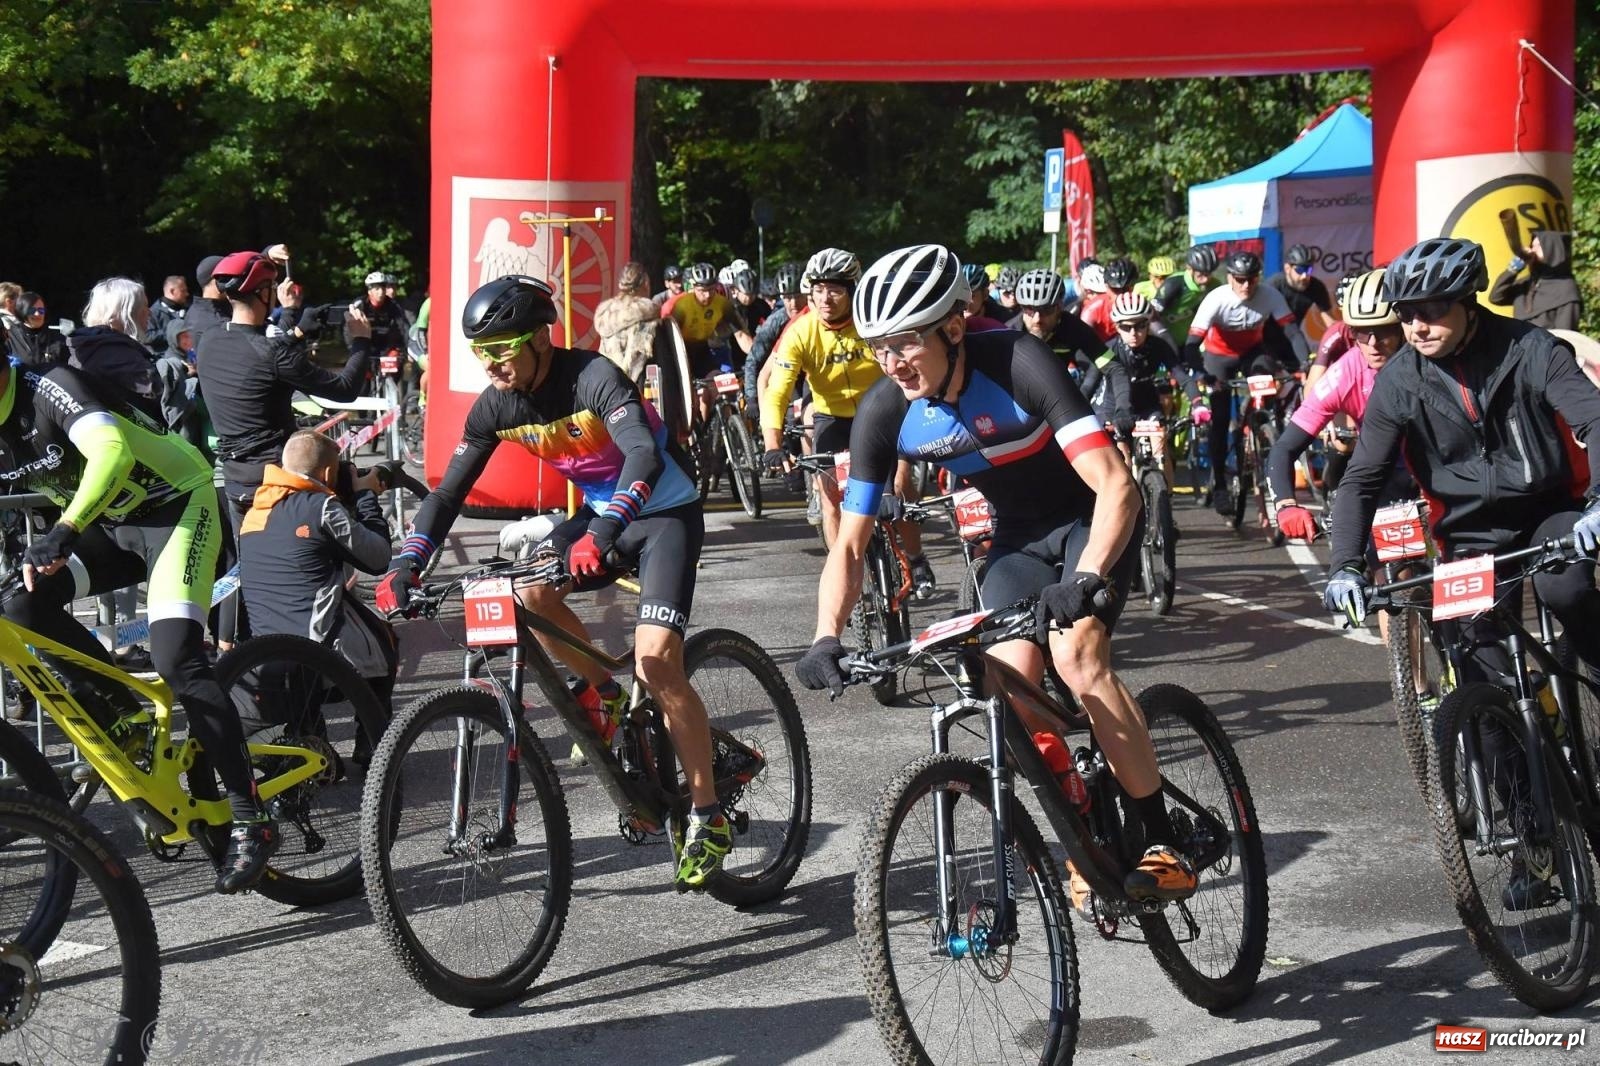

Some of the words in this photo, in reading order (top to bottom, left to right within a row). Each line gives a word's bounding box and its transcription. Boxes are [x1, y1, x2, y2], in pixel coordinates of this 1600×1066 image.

[1048, 154, 1060, 193] P
[917, 436, 944, 455] TOMAZI
[932, 445, 953, 457] TEAM
[183, 508, 210, 587] SPORTGANG
[1442, 576, 1483, 598] 163
[475, 602, 503, 621] 119
[1005, 843, 1014, 881] SWISS
